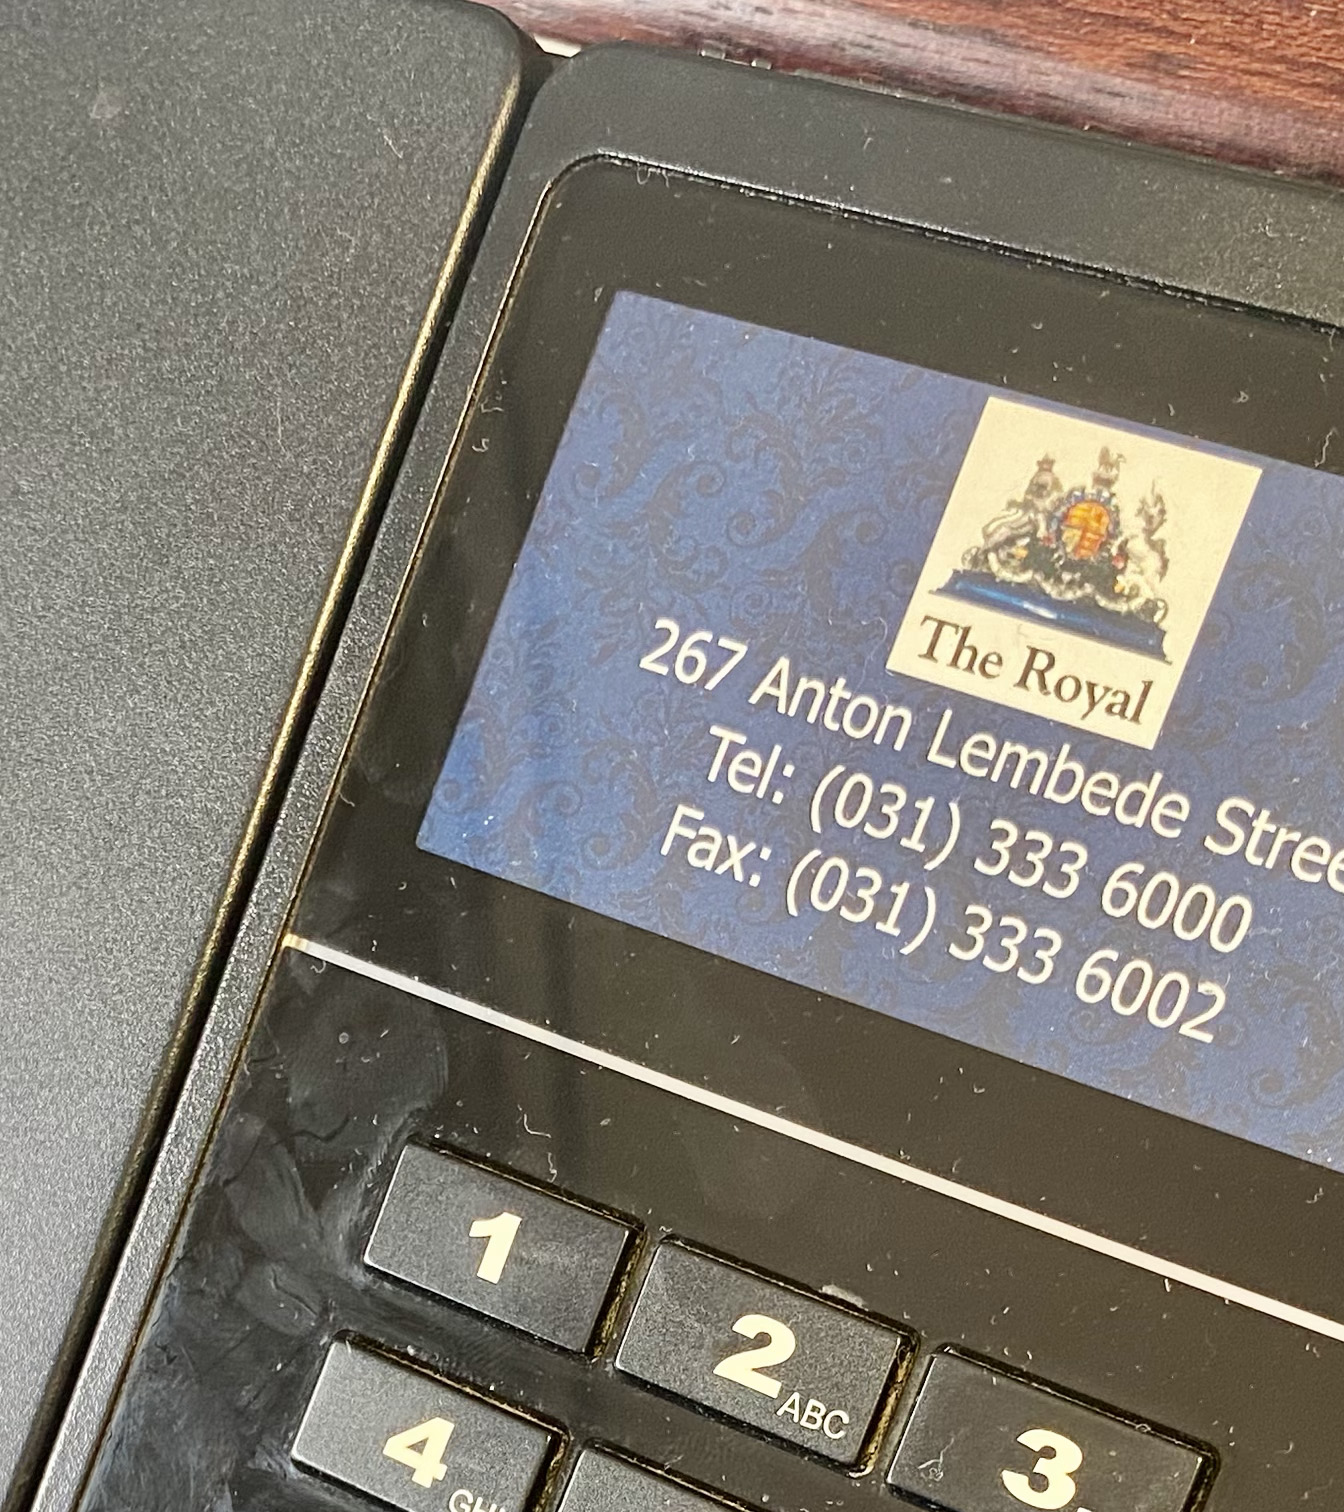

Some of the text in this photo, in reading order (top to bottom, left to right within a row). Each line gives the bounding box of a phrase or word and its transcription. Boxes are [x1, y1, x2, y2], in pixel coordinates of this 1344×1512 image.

[638, 618, 747, 692] 267
[749, 655, 915, 752] Anton
[926, 708, 1190, 840] Lembede
[919, 614, 1155, 727] The Royal
[707, 727, 1254, 955] Tel: (031) 333 6000
[660, 807, 1228, 1045] Fax: (031) 333 6002
[468, 1211, 522, 1284] 1
[712, 1313, 851, 1441] 2 ABC
[383, 1416, 454, 1488] 4
[1000, 1428, 1083, 1511] 3
